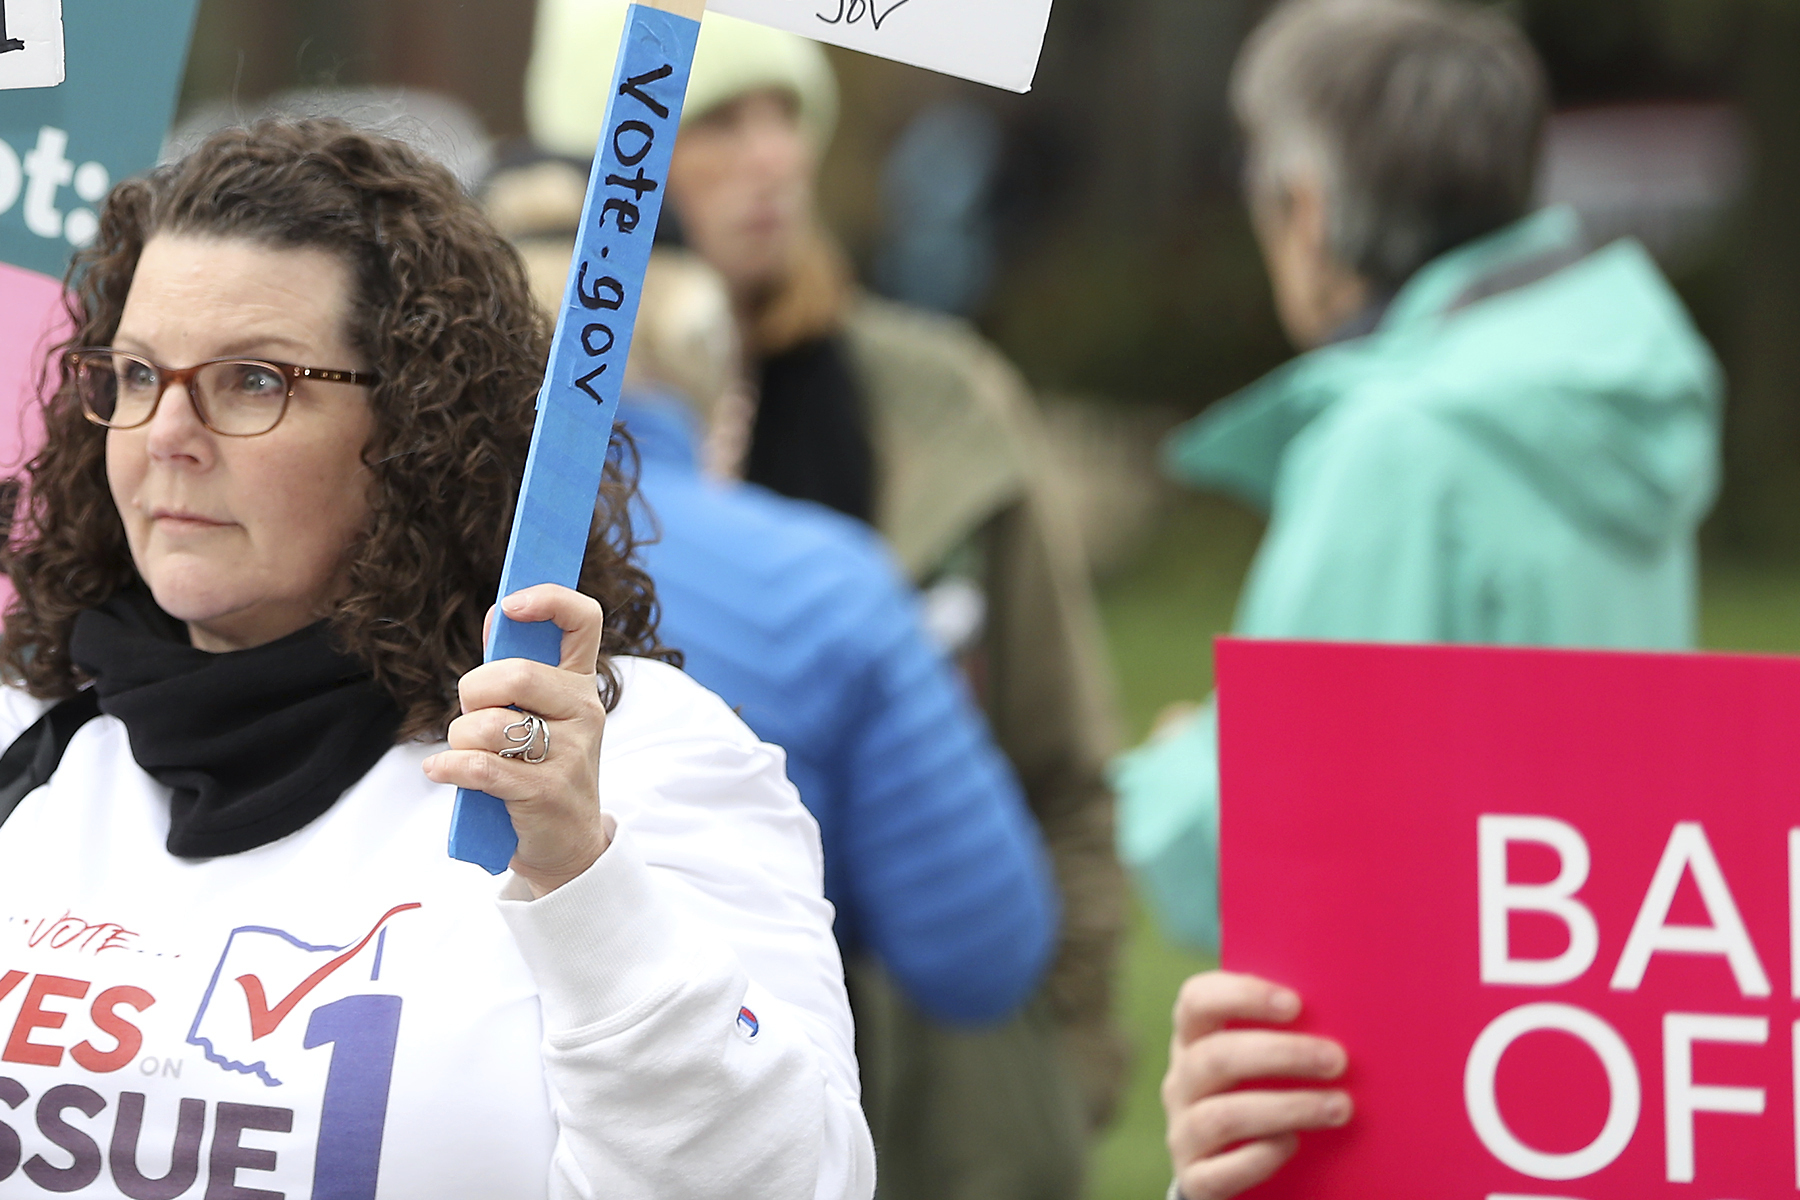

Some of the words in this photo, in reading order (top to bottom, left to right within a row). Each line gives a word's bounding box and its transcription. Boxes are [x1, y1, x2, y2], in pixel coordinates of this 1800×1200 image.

[1476, 813, 1800, 1000] BA
[138, 1056, 183, 1079] ON
[303, 994, 403, 1200] 1
[1464, 1001, 1800, 1188] OF
